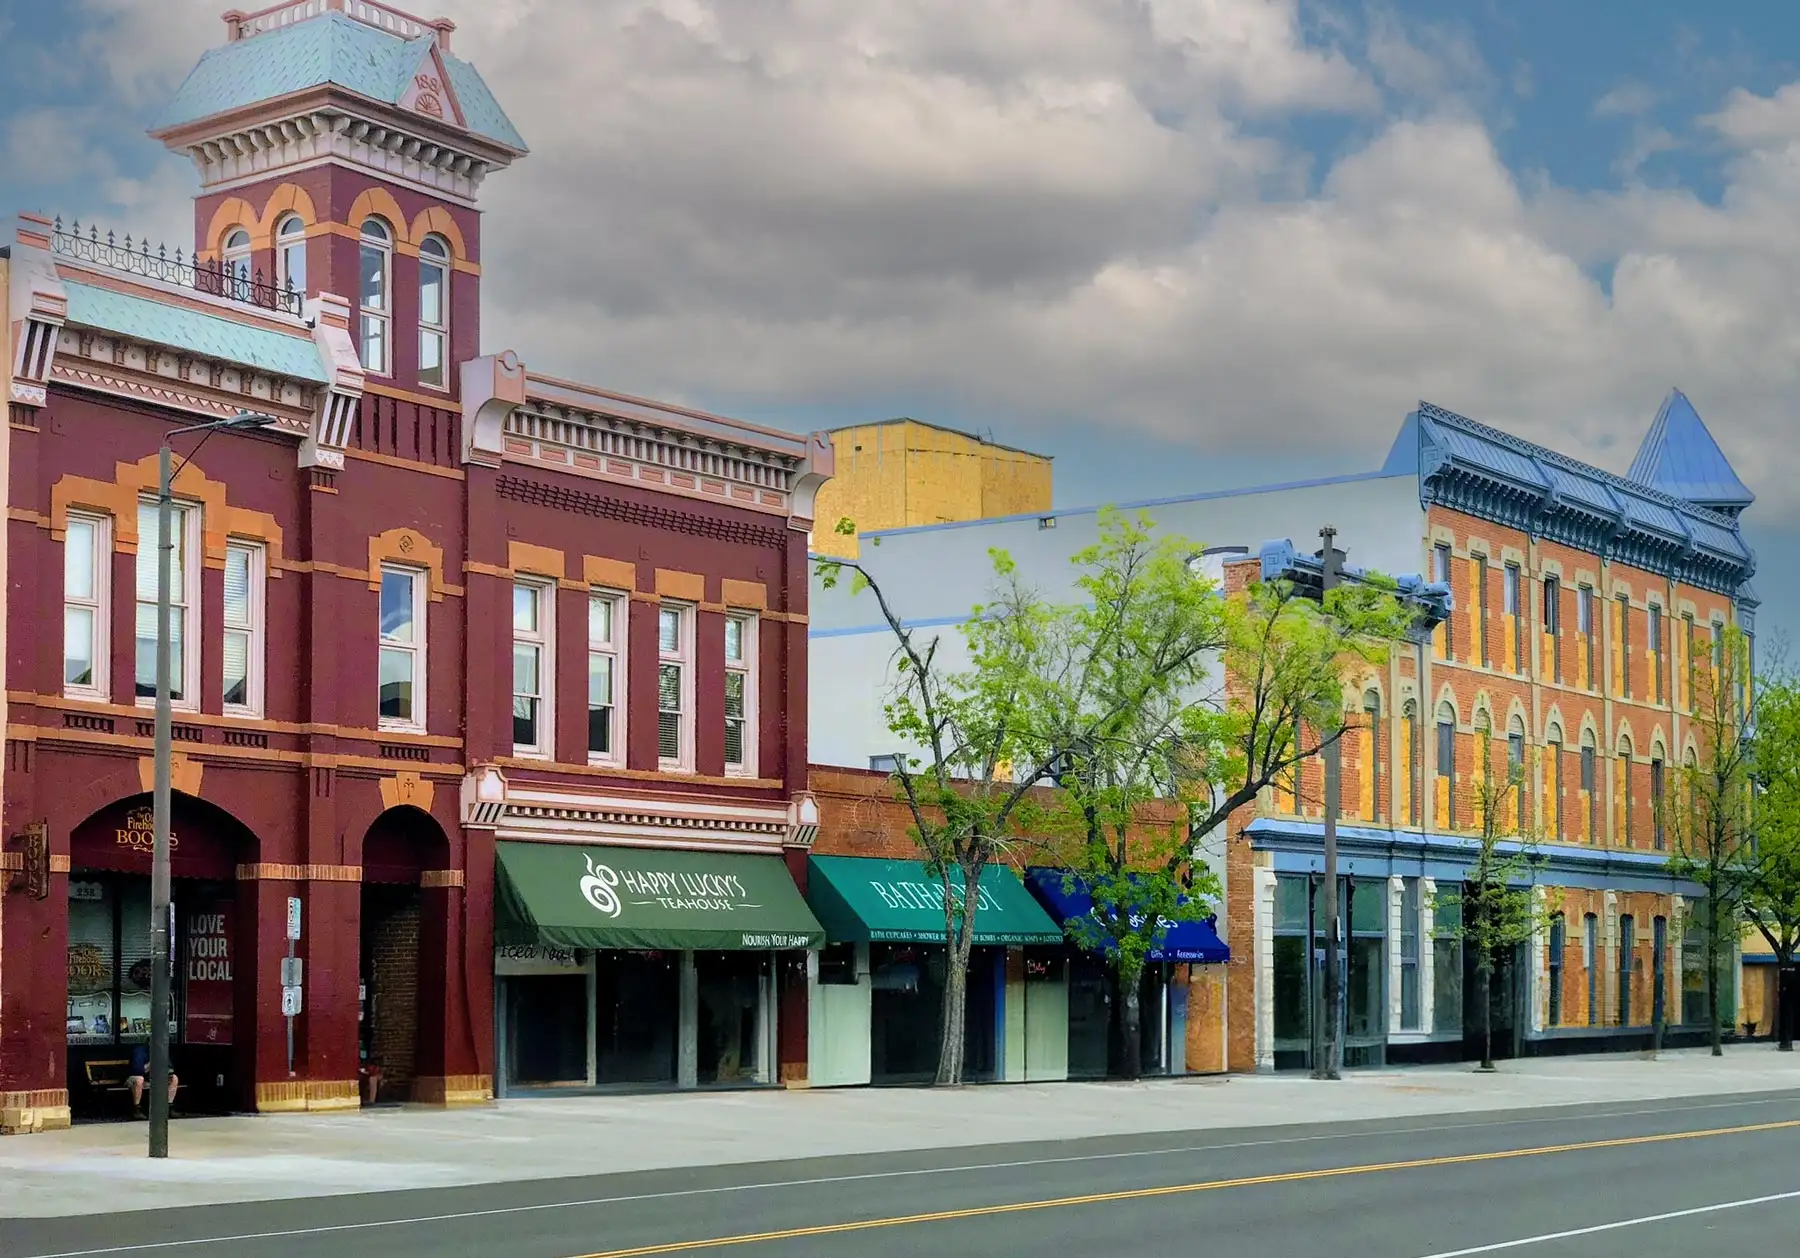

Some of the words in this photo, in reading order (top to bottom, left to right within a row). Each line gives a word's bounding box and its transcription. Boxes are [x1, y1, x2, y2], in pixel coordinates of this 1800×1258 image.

[115, 829, 179, 846] BOOS
[28, 834, 39, 896] BOOKS
[619, 870, 681, 895] HAPPY
[679, 873, 746, 897] LUCKY'S
[656, 897, 734, 911] TEAHOUSE
[869, 881, 943, 910] BATH
[190, 914, 226, 934] LOVE
[189, 937, 228, 958] YOUR
[771, 933, 788, 946] YOUR
[788, 934, 809, 947] HAPPY
[68, 964, 112, 977] OOKS
[188, 960, 233, 981] LOCAL
